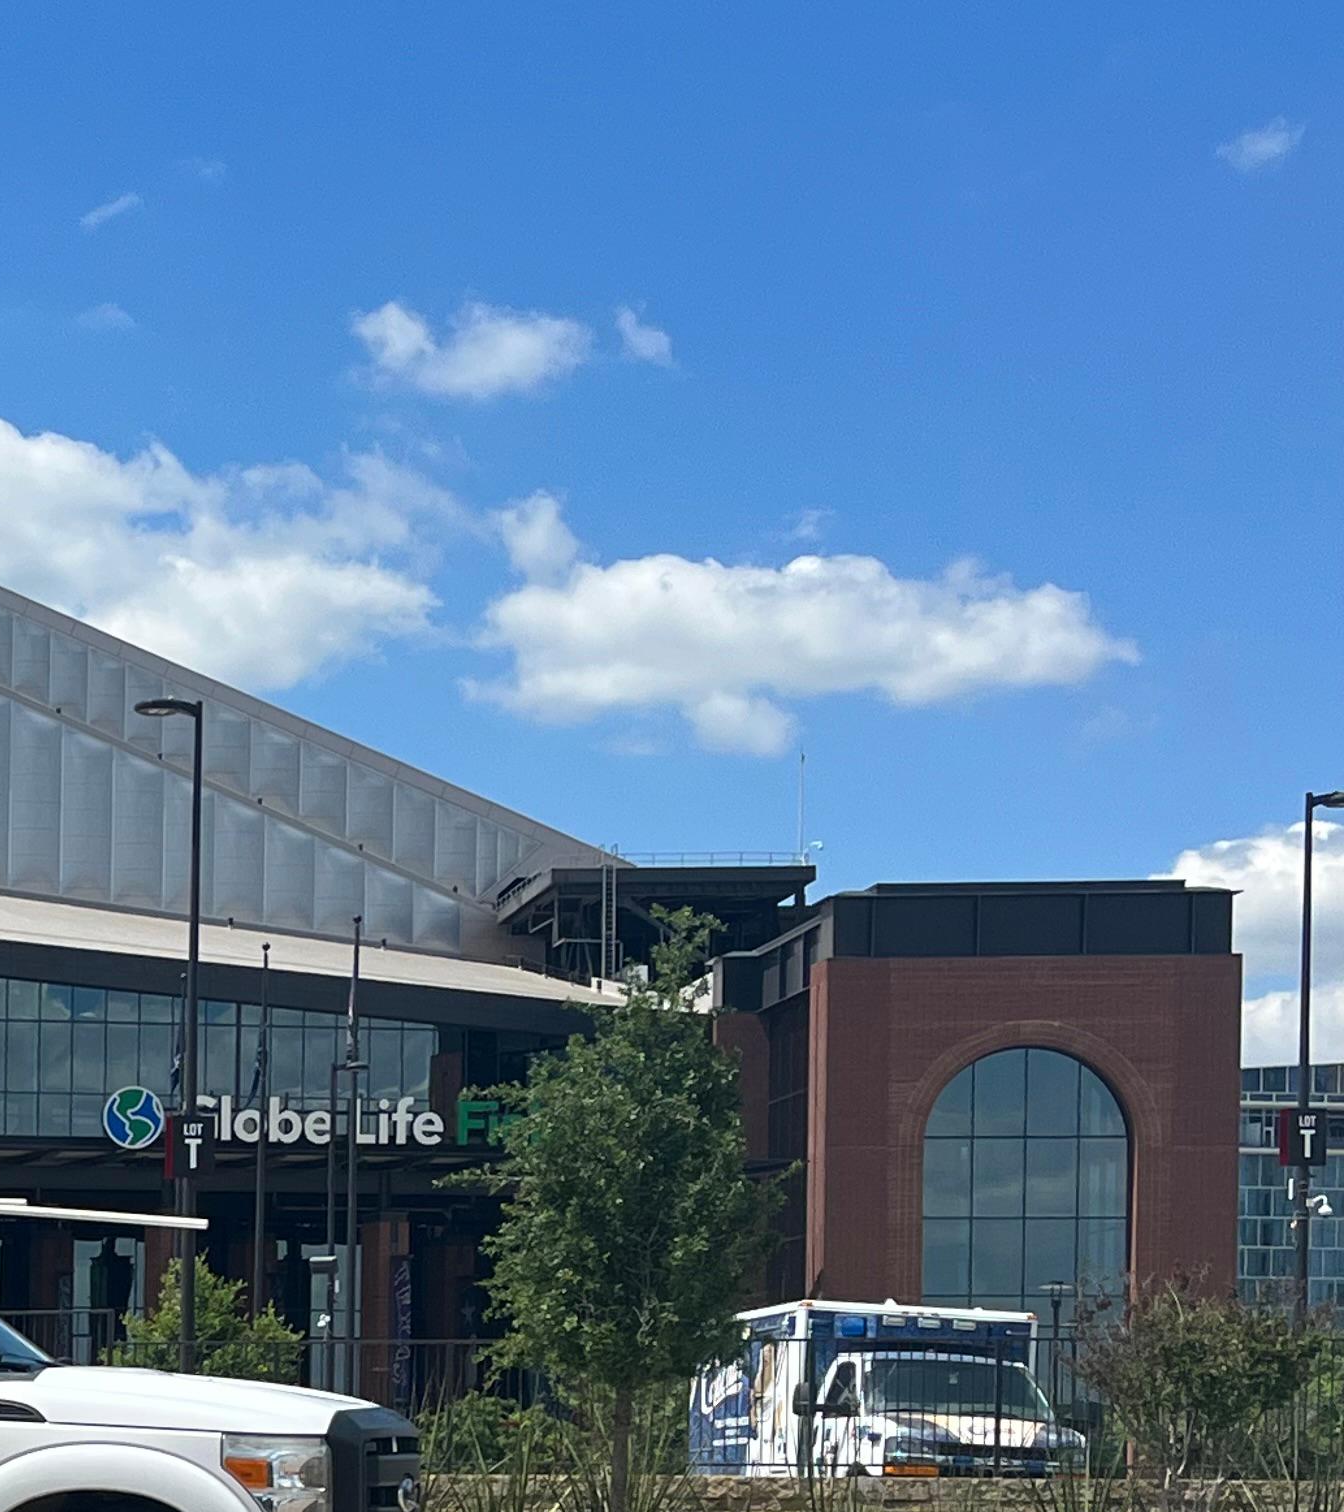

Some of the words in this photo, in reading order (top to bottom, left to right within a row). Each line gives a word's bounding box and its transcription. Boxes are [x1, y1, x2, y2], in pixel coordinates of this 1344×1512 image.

[183, 1123, 204, 1136] LOT
[356, 1097, 444, 1145] Life
[1298, 1115, 1317, 1127] LOT
[184, 1138, 203, 1169] T
[1300, 1129, 1316, 1158] T
